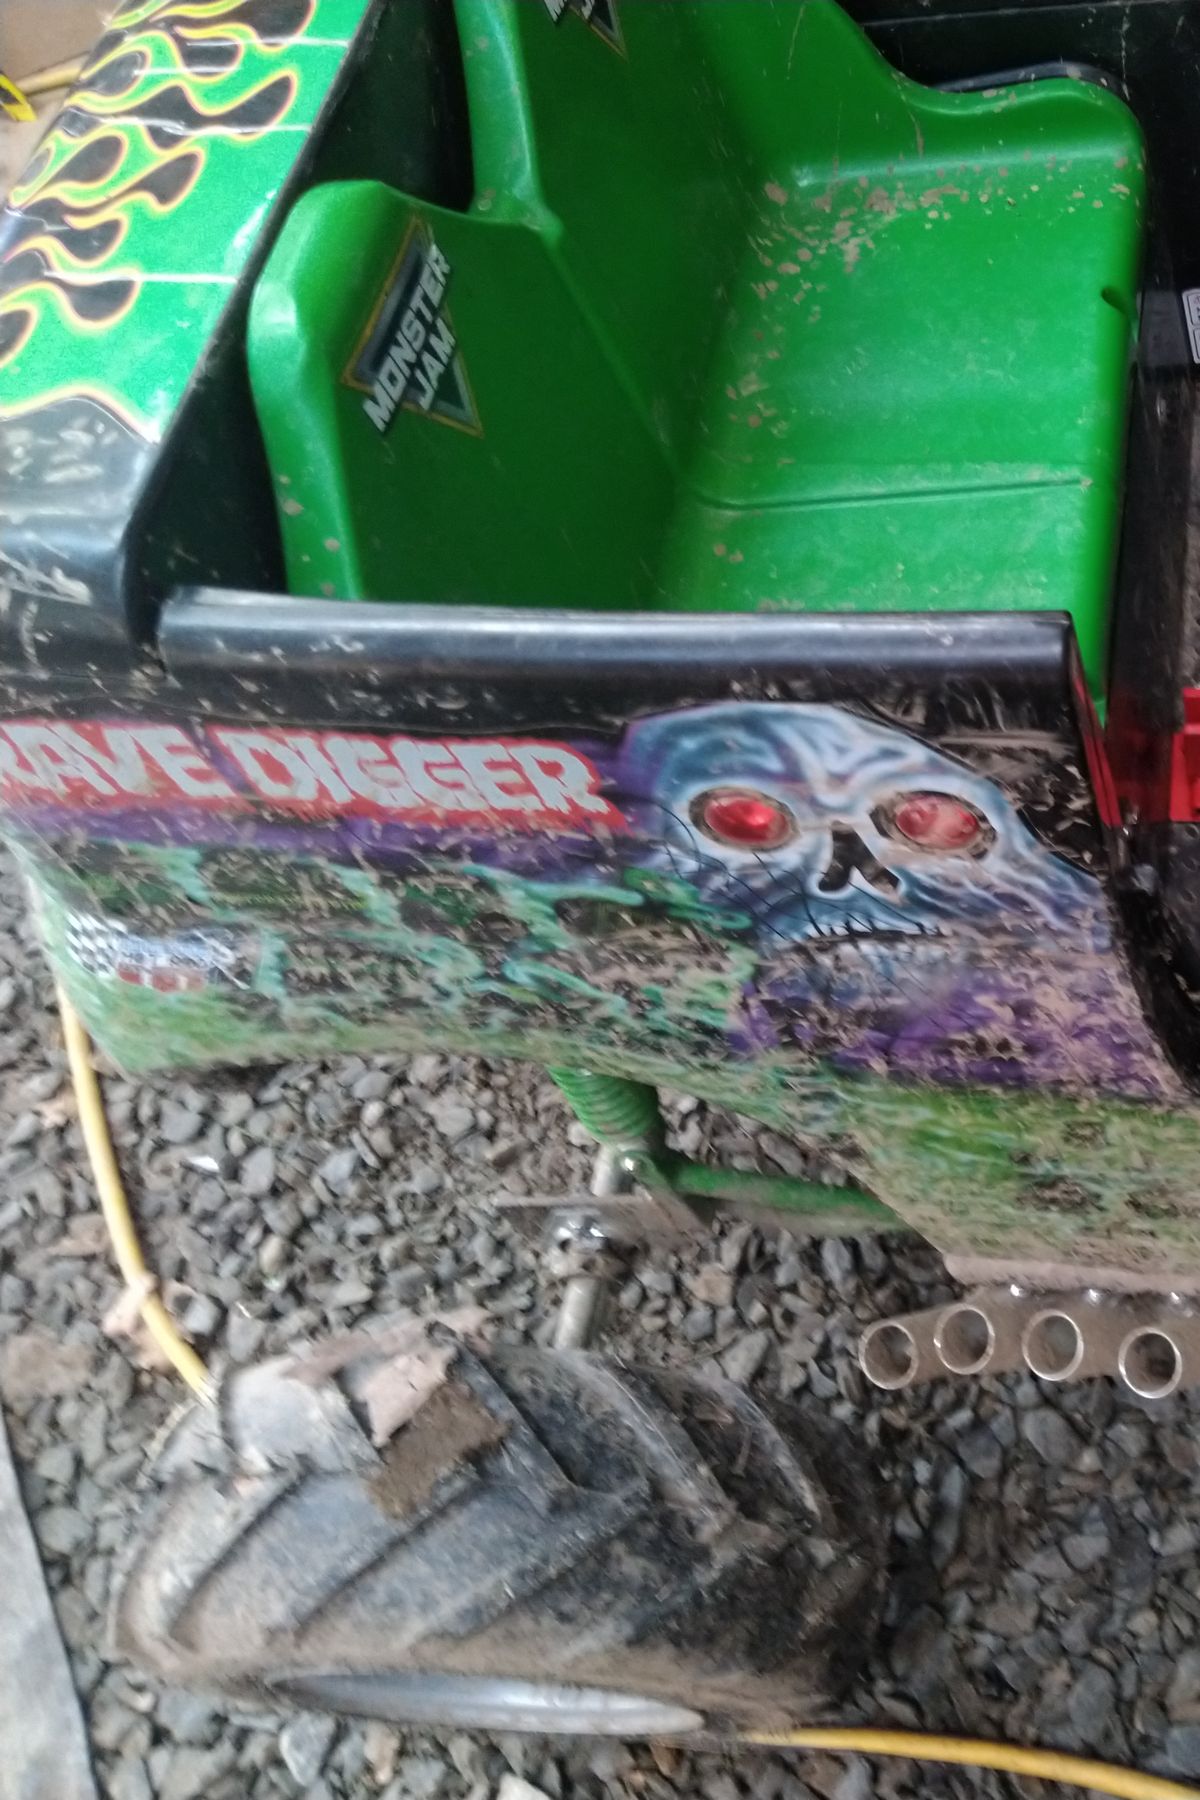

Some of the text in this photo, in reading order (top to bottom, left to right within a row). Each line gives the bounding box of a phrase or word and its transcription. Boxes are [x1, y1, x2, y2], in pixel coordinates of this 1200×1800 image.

[362, 243, 450, 432] MONSTER
[414, 316, 456, 411] JAM
[215, 729, 612, 814] DIGGER
